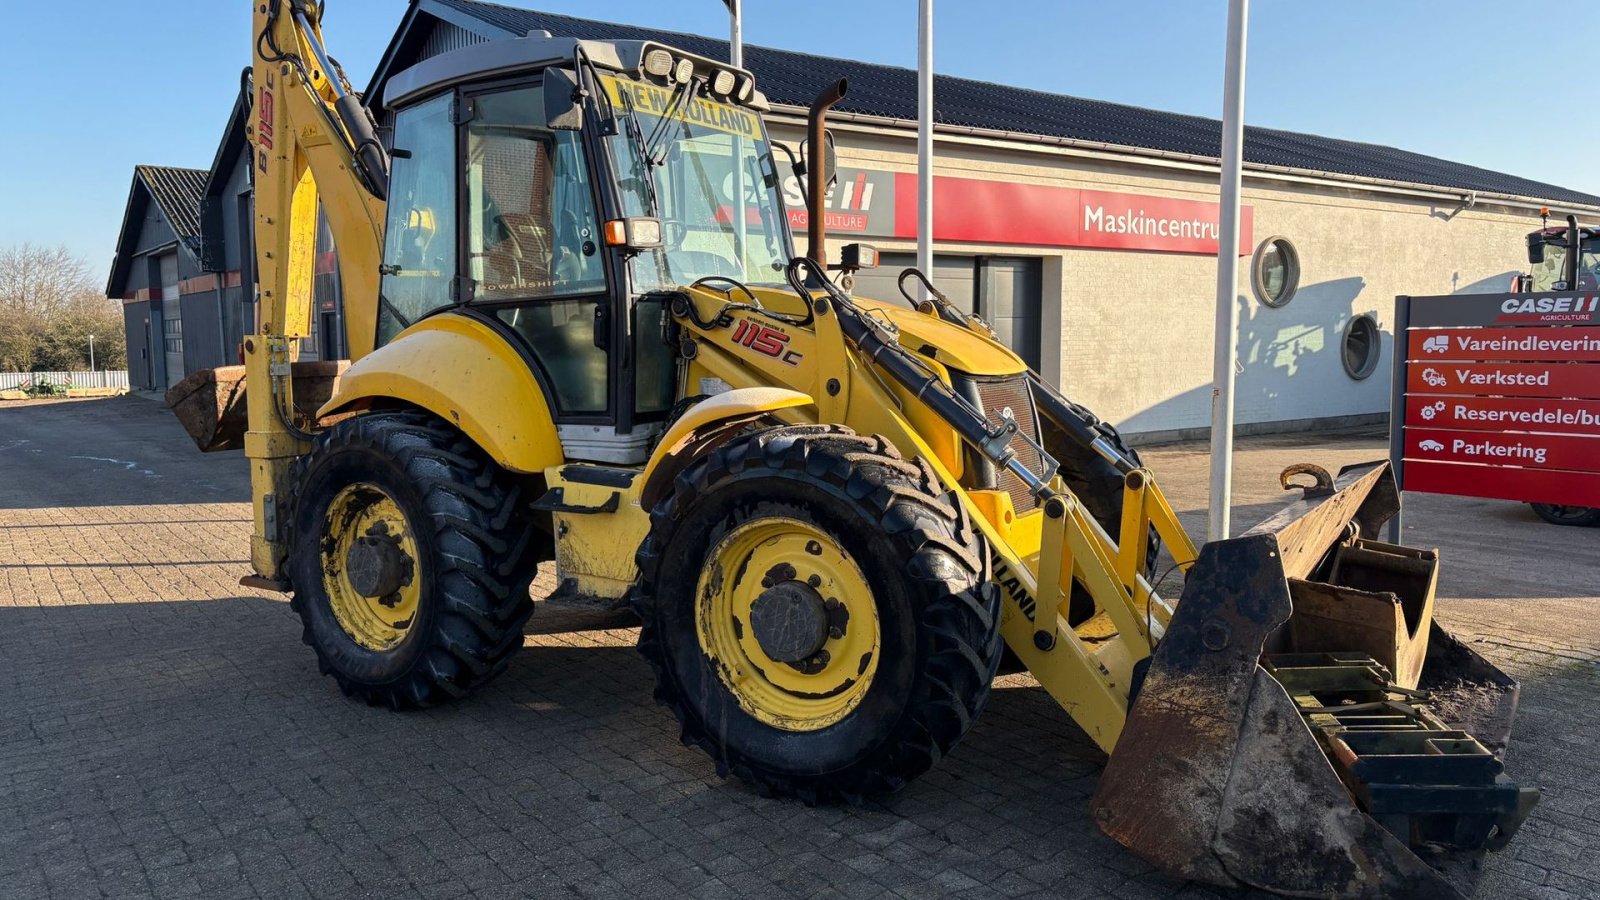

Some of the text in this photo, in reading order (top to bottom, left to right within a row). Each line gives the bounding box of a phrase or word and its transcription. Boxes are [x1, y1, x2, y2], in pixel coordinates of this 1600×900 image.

[615, 80, 753, 135] NEW OLLAND
[791, 213, 863, 228] AGULTURE
[1084, 205, 1220, 241] Maskincentru
[1501, 297, 1573, 313] CASE
[731, 319, 790, 357] 115
[1456, 369, 1549, 386] Værksted
[1452, 439, 1547, 463] Parkering
